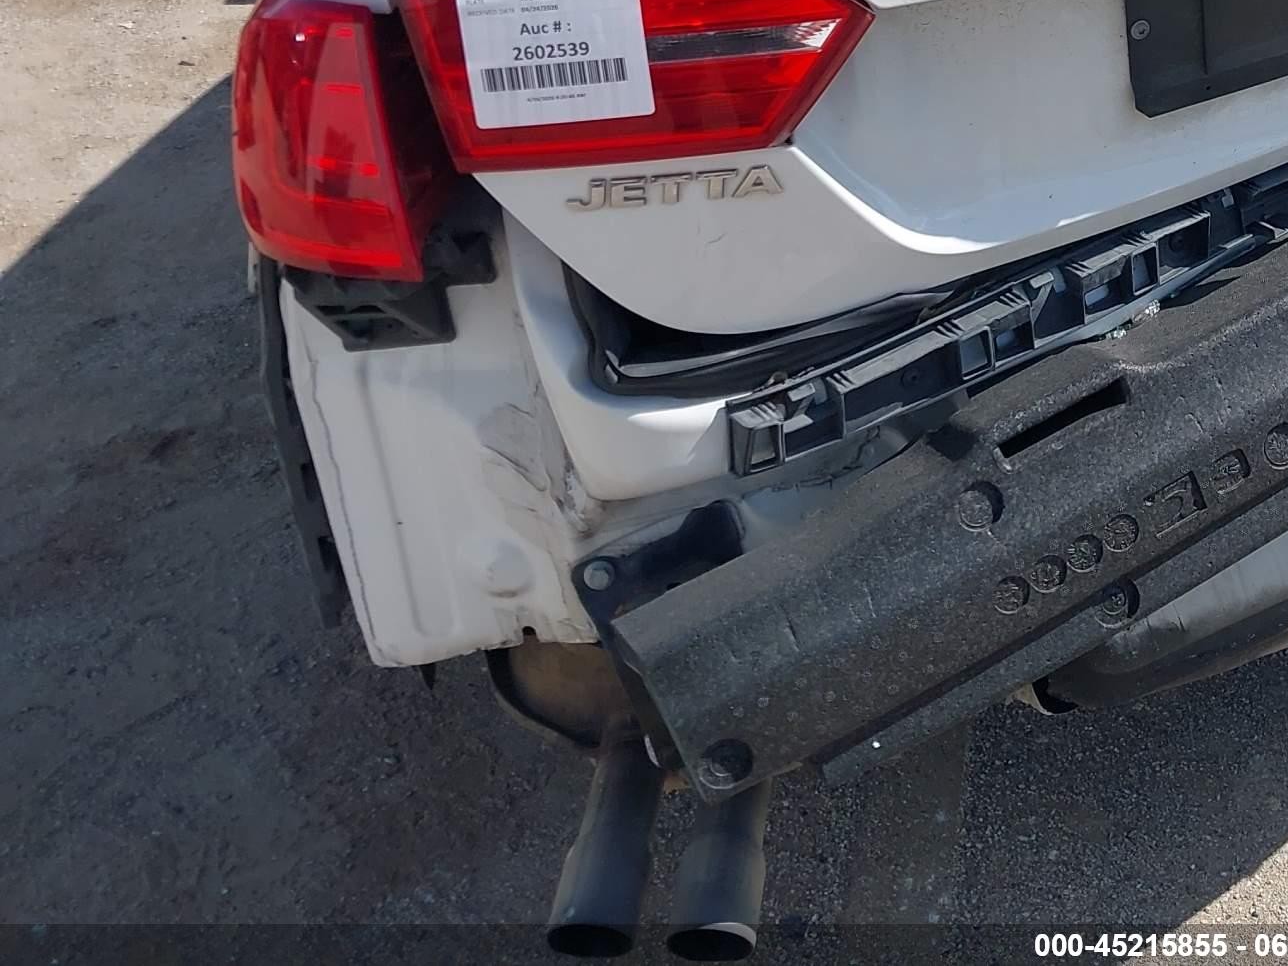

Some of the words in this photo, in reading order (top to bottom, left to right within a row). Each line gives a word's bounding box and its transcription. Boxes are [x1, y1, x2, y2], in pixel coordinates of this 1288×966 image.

[519, 22, 550, 36] Auc
[552, 20, 562, 33] #
[512, 41, 590, 62] 2602539
[565, 164, 784, 212] JETTA
